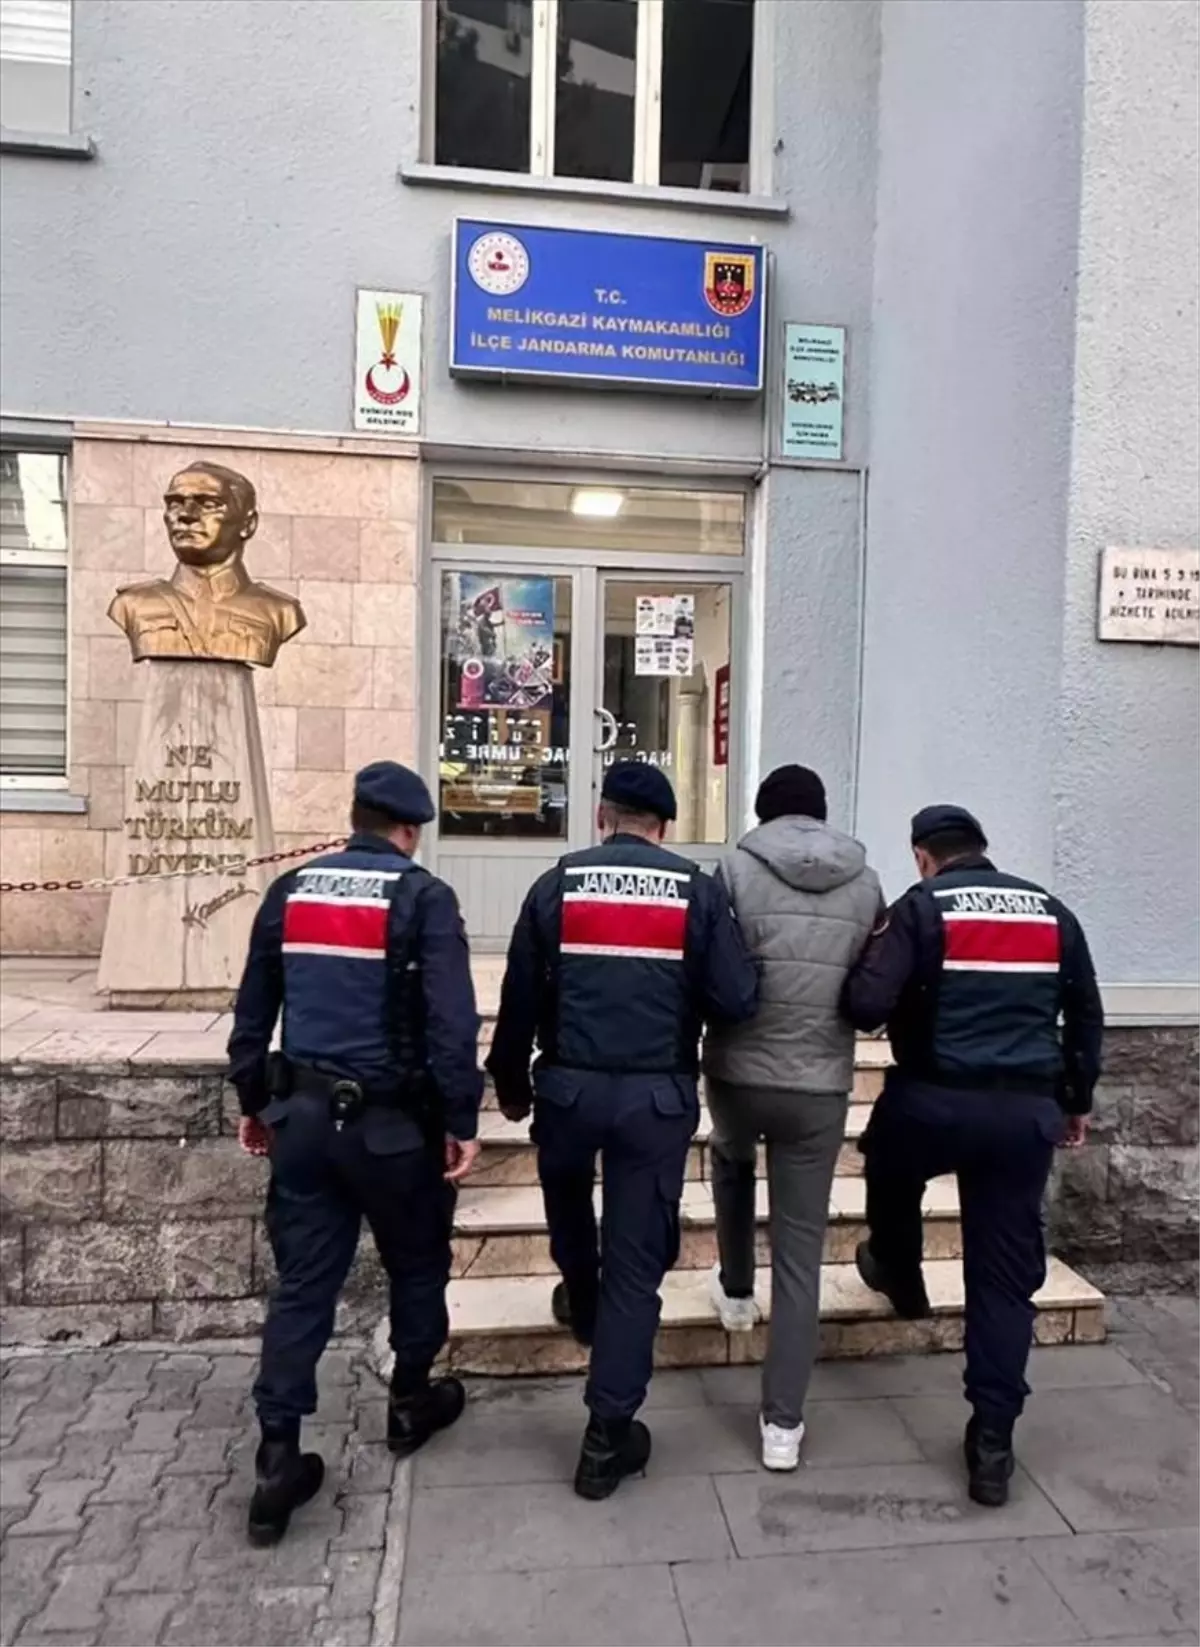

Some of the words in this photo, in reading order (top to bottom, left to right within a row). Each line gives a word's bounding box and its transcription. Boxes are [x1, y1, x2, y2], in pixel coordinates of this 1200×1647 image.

[594, 288, 628, 304] T.C.
[487, 307, 588, 328] MELİKGAZİ
[592, 315, 731, 339] KAYMAKAMLIĞI
[471, 332, 512, 353] İLÇE
[518, 338, 617, 358] JANDARMA
[622, 345, 745, 366] KOMUTANLIĞI
[165, 744, 213, 769] NE
[135, 778, 241, 804] MUTLU
[124, 808, 254, 841] TÜRKÜM
[577, 872, 679, 899] JANDARMA
[952, 892, 1047, 915] JANDARMA
